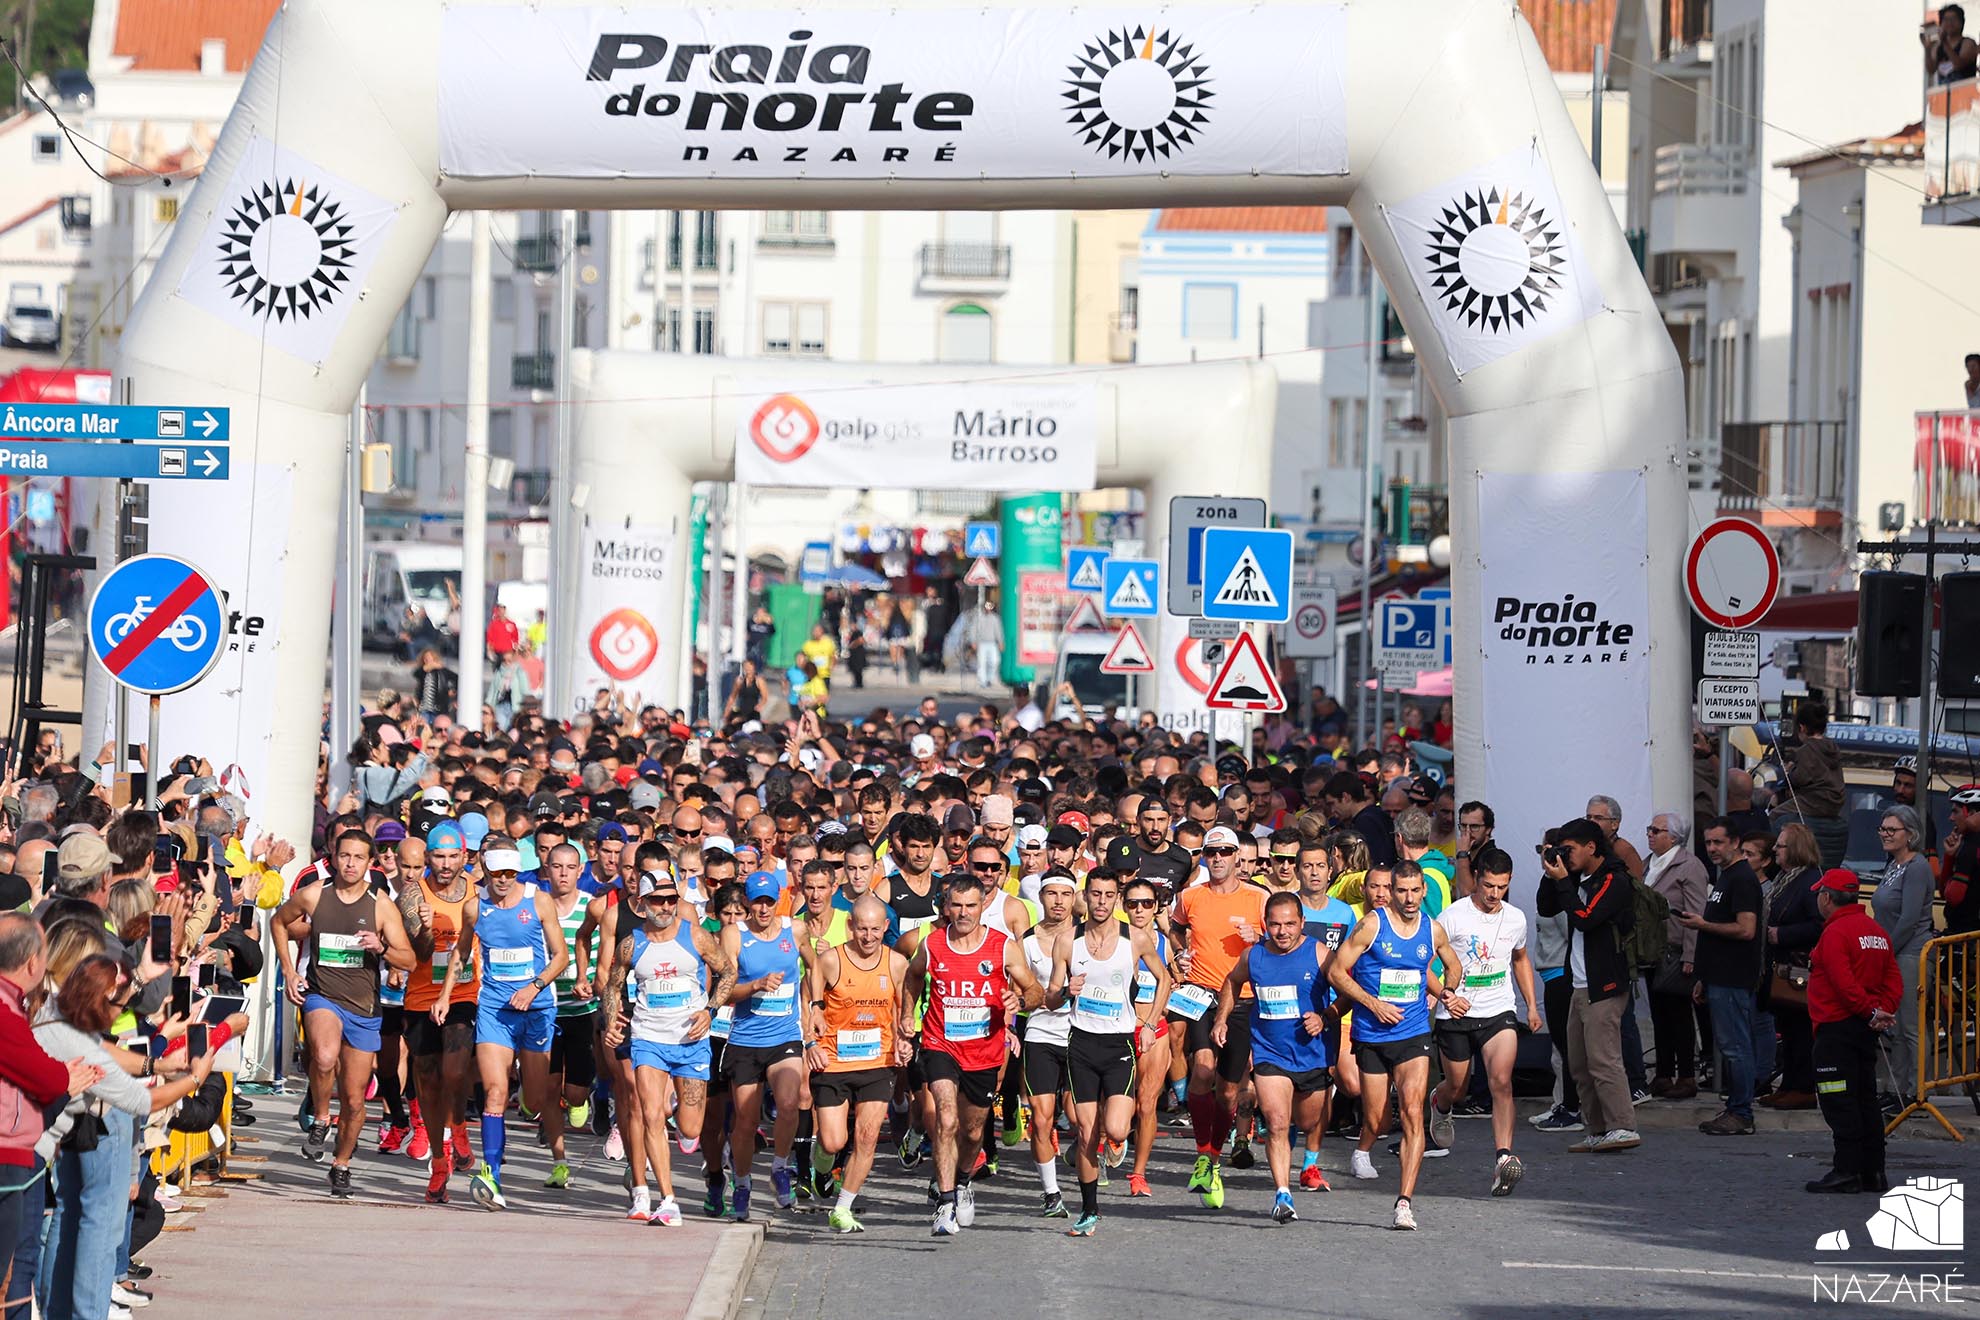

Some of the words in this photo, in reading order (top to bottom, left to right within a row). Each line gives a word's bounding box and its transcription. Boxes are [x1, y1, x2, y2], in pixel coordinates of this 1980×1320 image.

[586, 30, 872, 85] Praia
[604, 84, 681, 117] do
[685, 83, 974, 132] norte
[3, 406, 76, 434] Âncora
[82, 413, 120, 434] Mar
[825, 417, 877, 441] galp
[953, 409, 1058, 438] Mário
[0, 449, 49, 469] Praia
[951, 441, 1059, 464] Barroso
[1196, 507, 1238, 519] zona
[593, 539, 665, 563] Mário
[591, 562, 665, 580] Barroso
[1494, 594, 1597, 624] Praia
[1387, 606, 1415, 646] P
[1500, 623, 1527, 641] do
[1527, 620, 1634, 647] norte
[1382, 651, 1412, 659] RETIRE
[1404, 660, 1438, 668] BILHETE
[1713, 685, 1749, 694] EXCEPTO
[1704, 698, 1744, 707] VIATURAS
[1745, 698, 1757, 707] DA
[1709, 711, 1726, 719] CMN
[1734, 712, 1752, 720] SMN
[936, 980, 993, 997] SIRA
